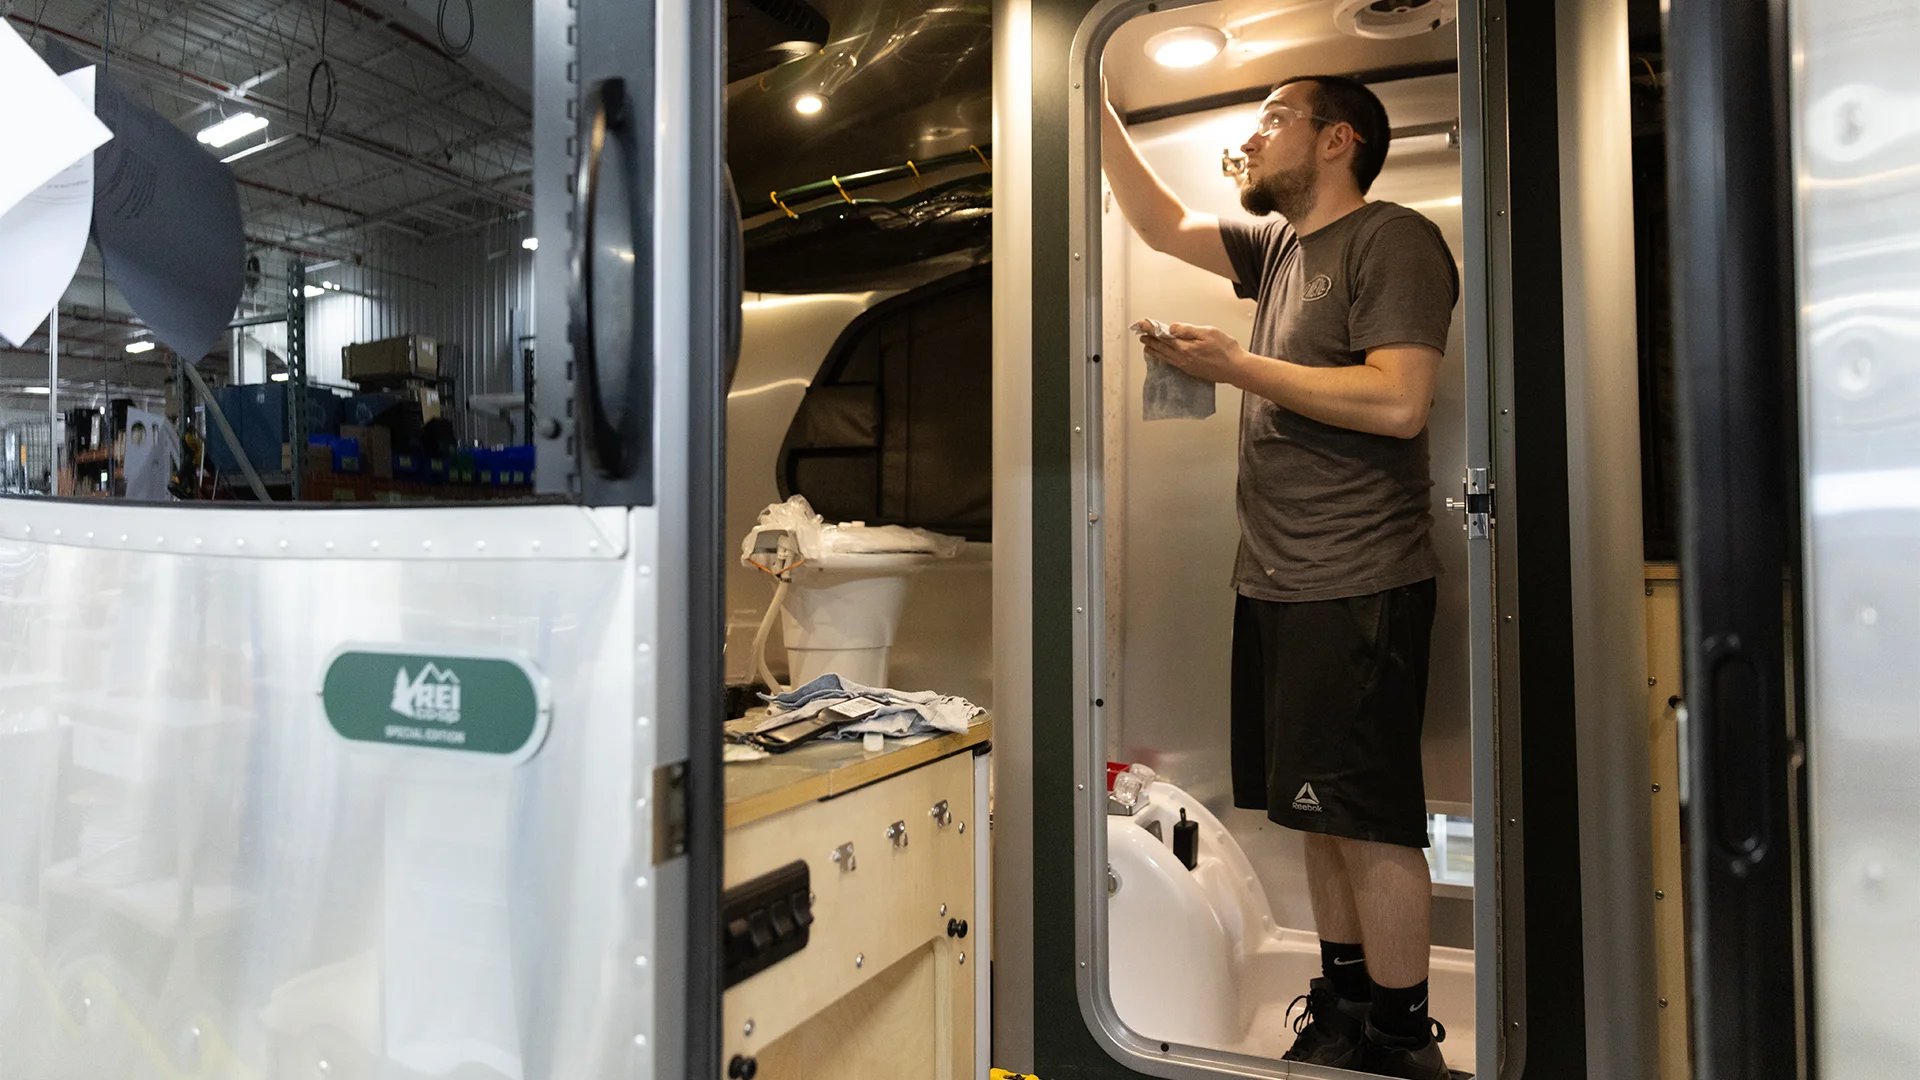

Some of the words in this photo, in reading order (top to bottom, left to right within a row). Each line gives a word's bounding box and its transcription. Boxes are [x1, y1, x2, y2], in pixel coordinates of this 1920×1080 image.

[415, 683, 461, 709] REI
[384, 725, 424, 740] SPECIAL
[424, 728, 466, 744] EDITION
[1292, 801, 1323, 813] Reebok
